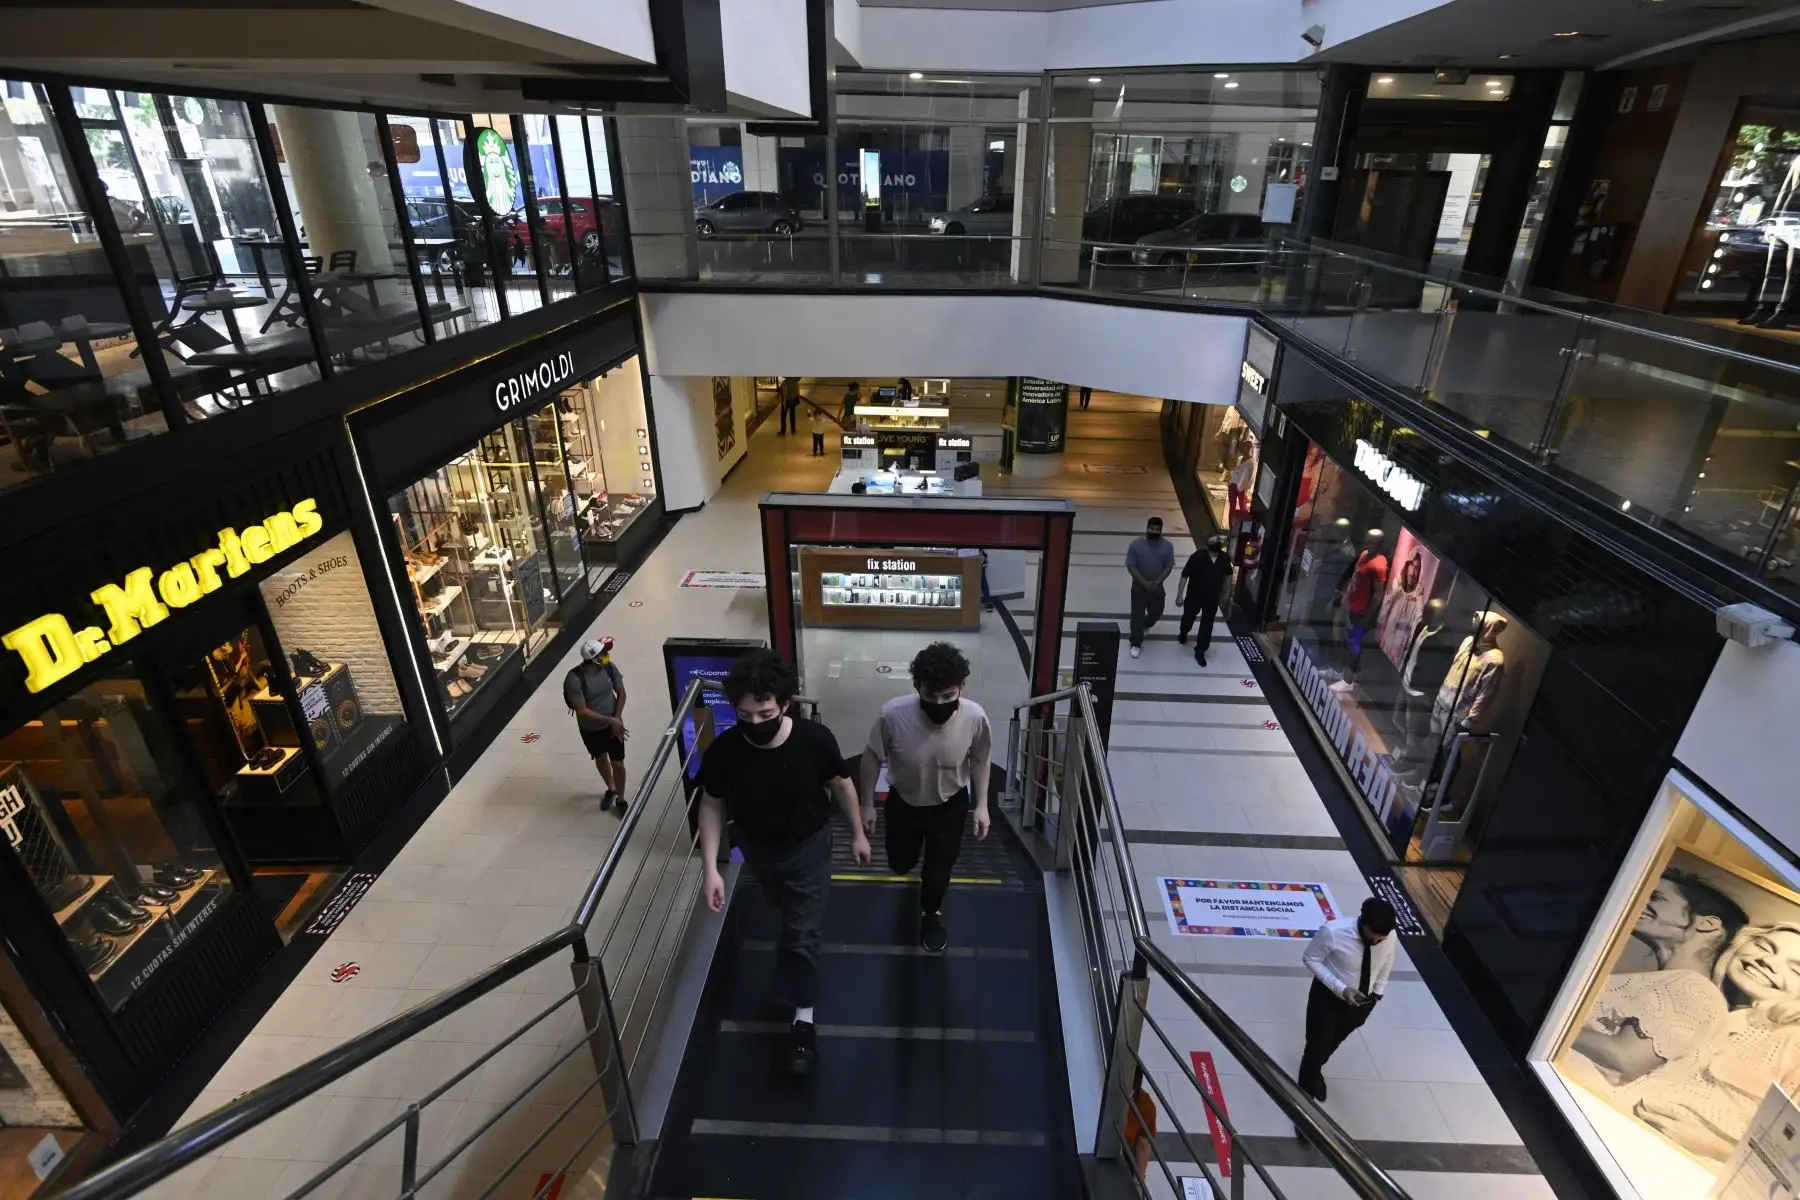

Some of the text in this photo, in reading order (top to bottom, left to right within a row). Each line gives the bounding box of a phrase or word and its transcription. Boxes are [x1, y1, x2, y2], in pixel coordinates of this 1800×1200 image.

[495, 350, 574, 411] GRIMOLDI
[1242, 361, 1265, 394] SWEET
[843, 436, 875, 445] fix station
[939, 437, 970, 447] fix station
[867, 558, 916, 571] fix station
[275, 556, 348, 608] BOOTS & SHOES
[1242, 899, 1305, 907] MANTENGAMOS
[130, 976, 143, 990] 12
[142, 945, 173, 978] CUOTAS
[172, 931, 187, 948] SIN
